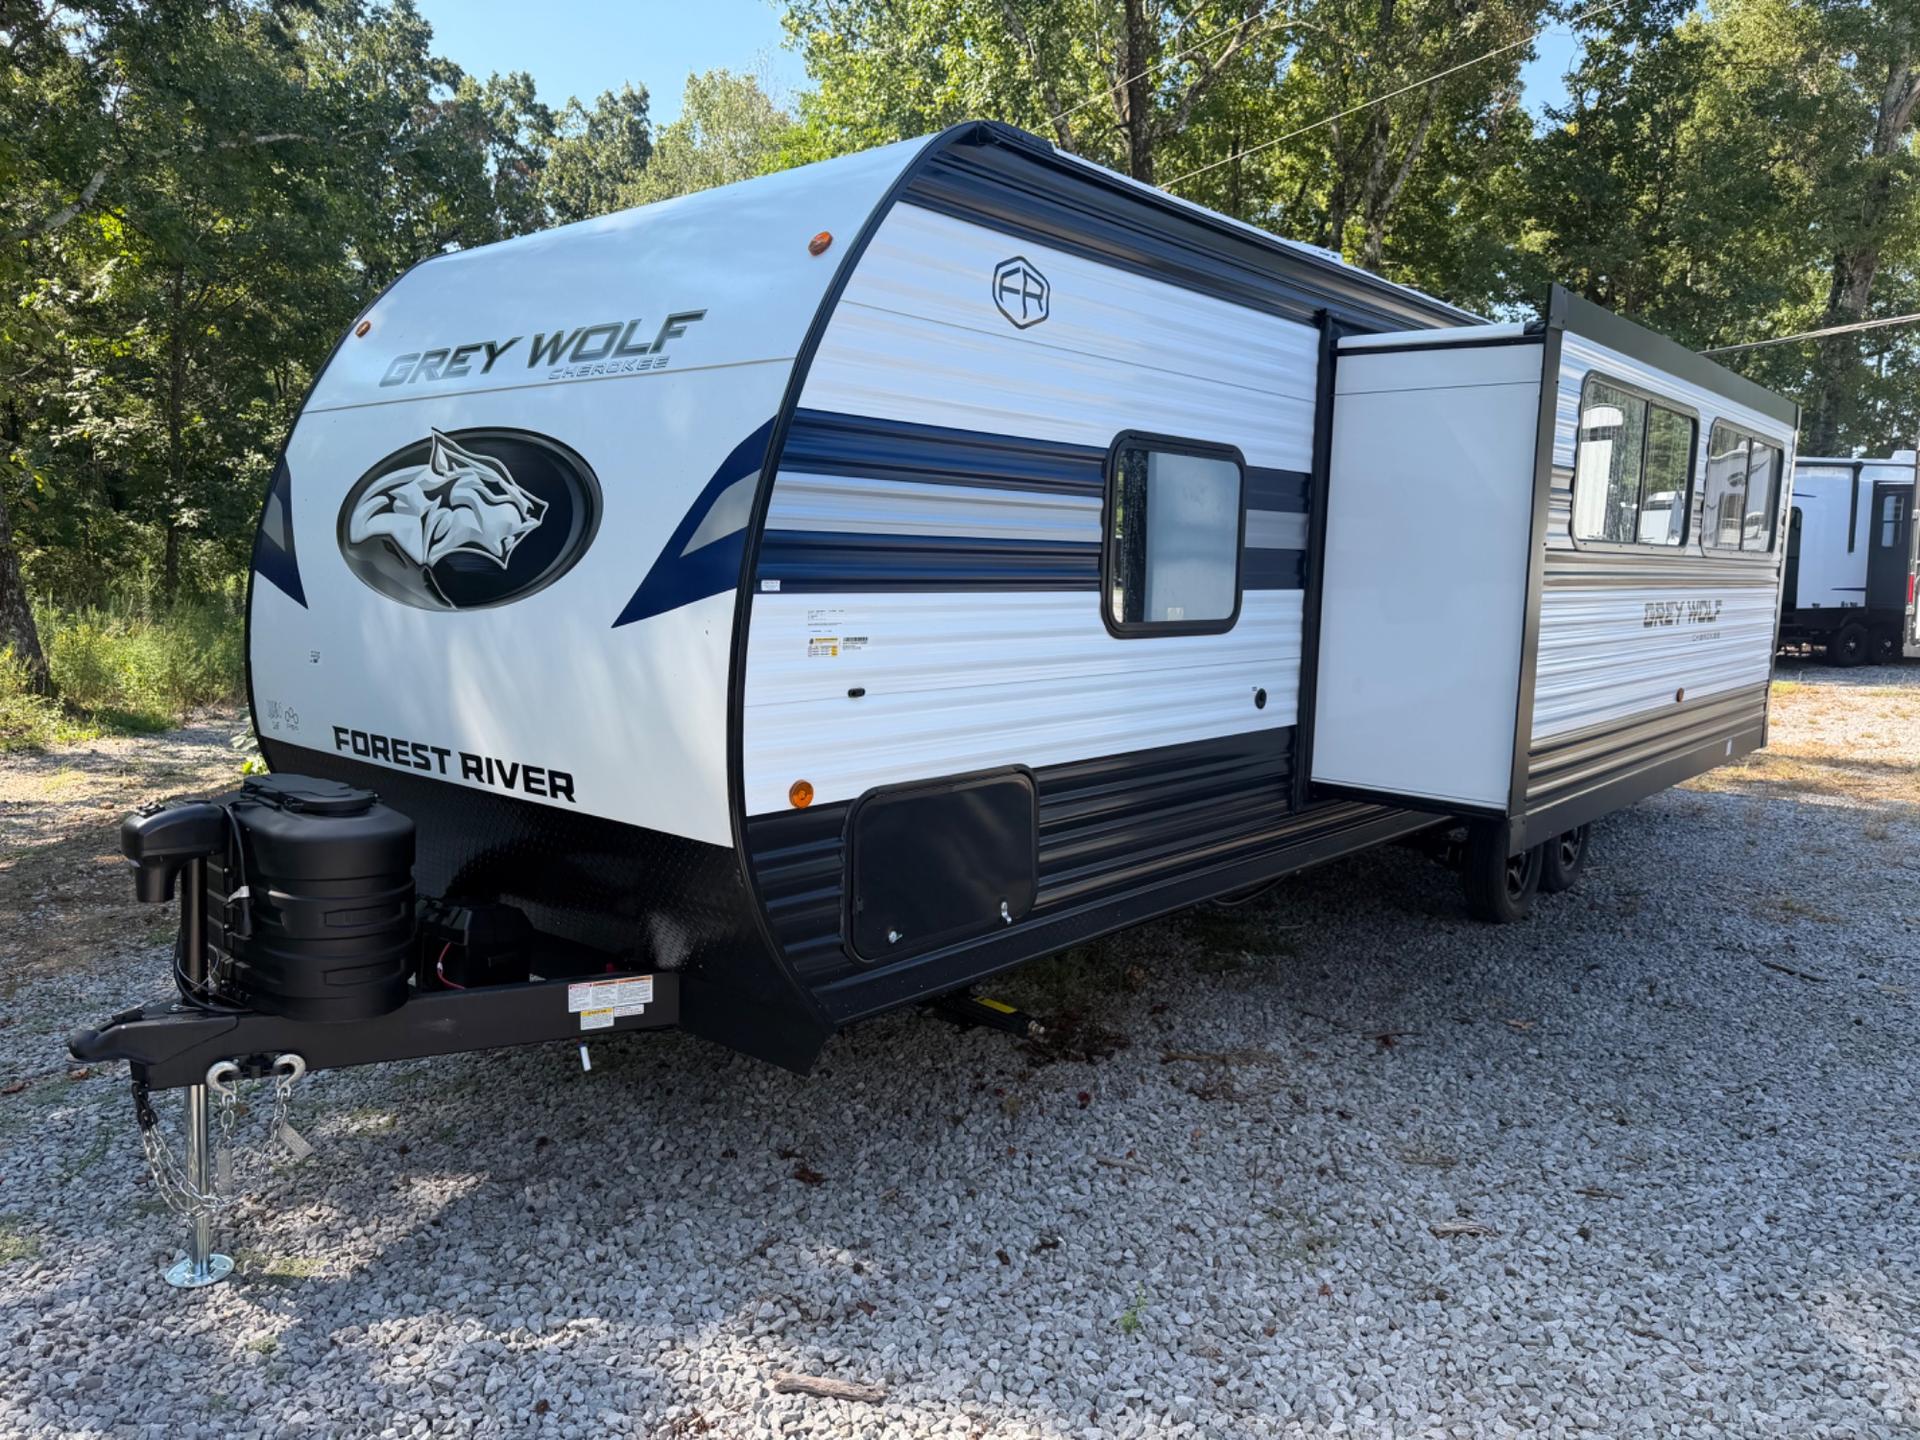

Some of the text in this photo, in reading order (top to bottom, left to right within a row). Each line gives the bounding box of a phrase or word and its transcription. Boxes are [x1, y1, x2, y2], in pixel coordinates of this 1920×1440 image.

[379, 308, 708, 388] GREY WOLF
[548, 356, 670, 380] CHEROKEE
[1643, 601, 1685, 628] GREY
[333, 726, 576, 802] FOREST RIVER
